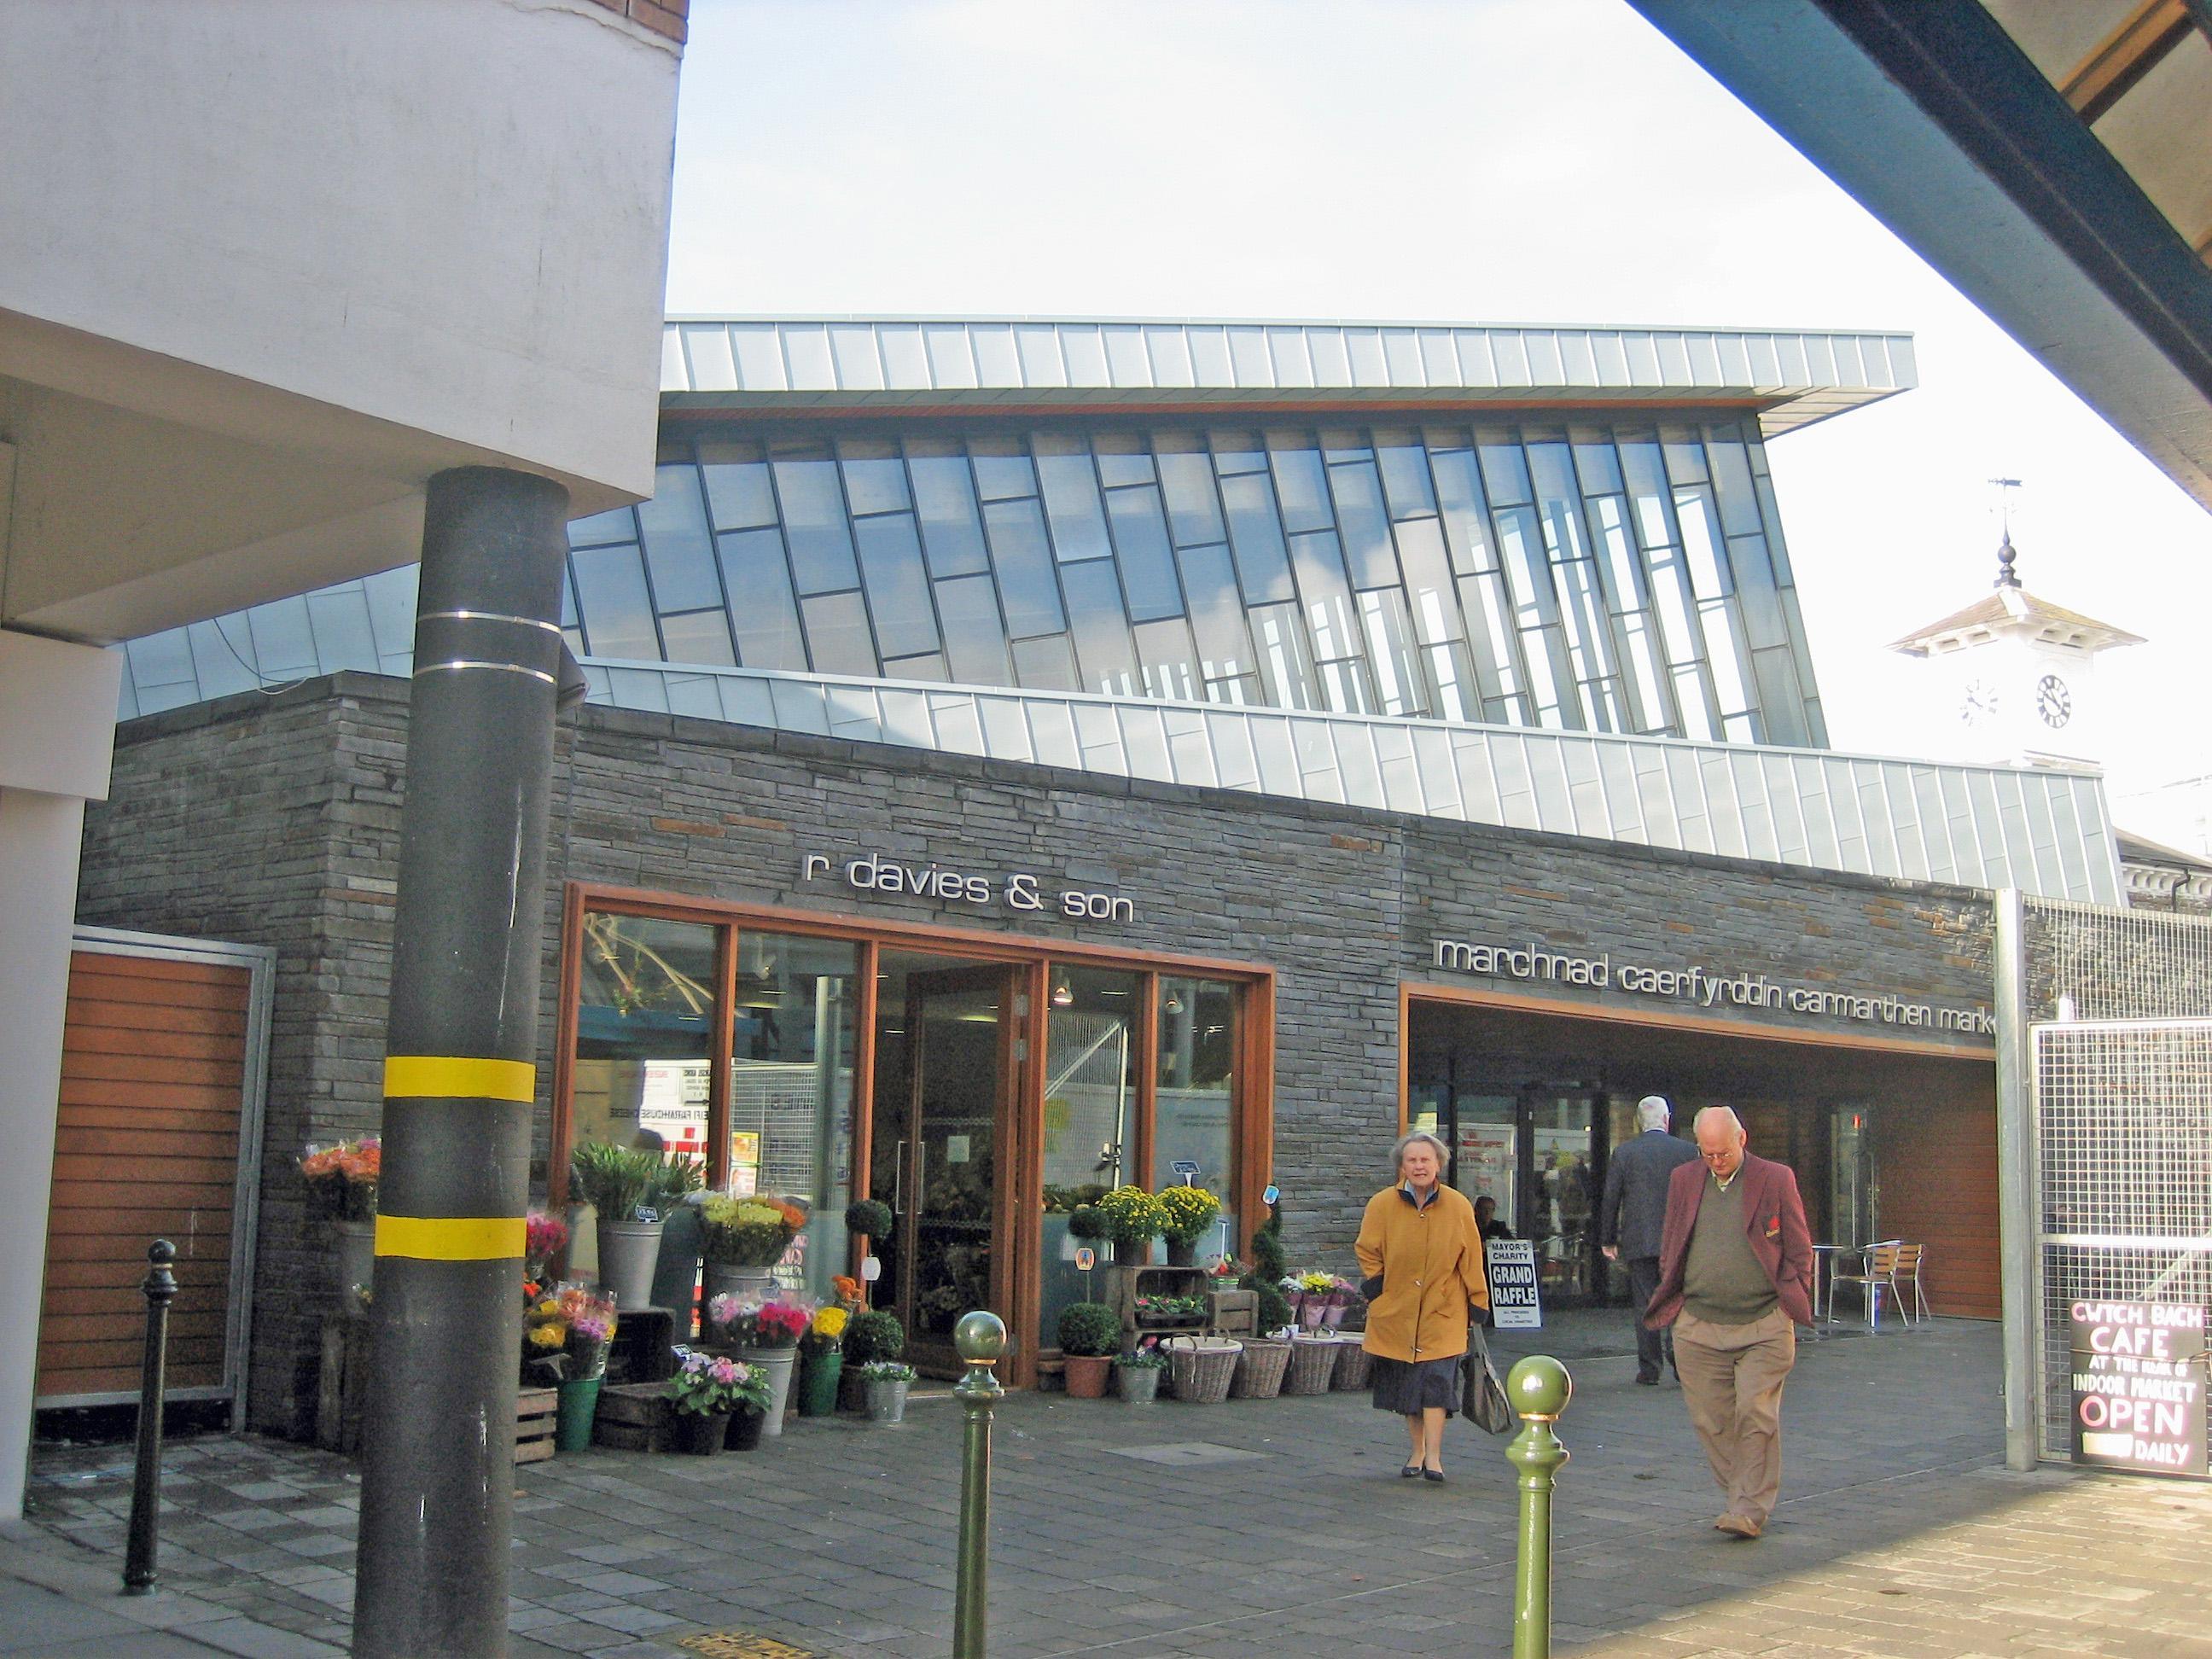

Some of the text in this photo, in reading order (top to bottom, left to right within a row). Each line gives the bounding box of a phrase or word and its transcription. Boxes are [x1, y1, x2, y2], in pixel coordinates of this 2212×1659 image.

[804, 853, 1133, 923] r davies & son
[1434, 940, 1997, 1035] marchnad caerfyrddin carmarthen mark
[1492, 1243, 1528, 1251] MAYOR'S
[1493, 1252, 1528, 1260] CHARITY
[1493, 1266, 1533, 1284] GRAND
[1494, 1286, 1536, 1305] RAFFLE
[2071, 1301, 2203, 1328] CWTCH BACH
[2090, 1326, 2169, 1357] CAFE
[2088, 1354, 2110, 1370] AT
[2113, 1356, 2139, 1373] THE
[2072, 1373, 2196, 1403] INDOOR MARKET
[2080, 1395, 2184, 1435] OPEN
[2134, 1440, 2190, 1465] DAILY
